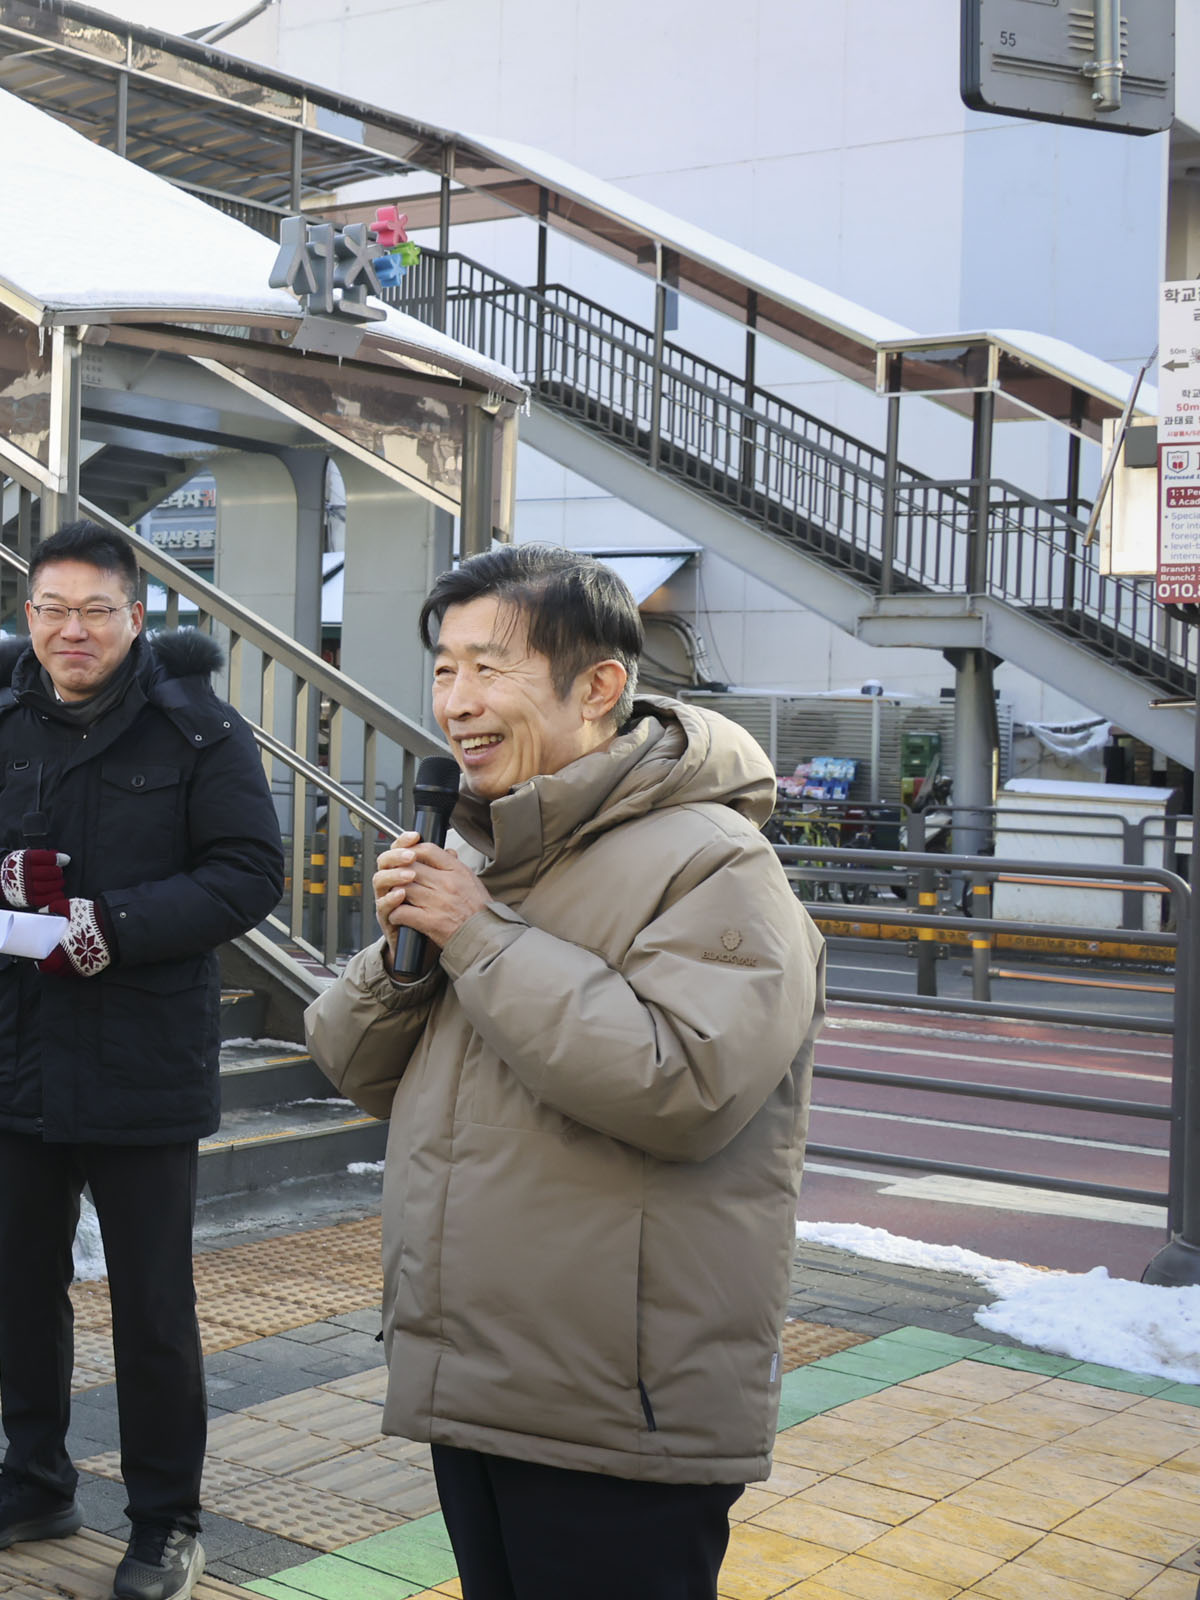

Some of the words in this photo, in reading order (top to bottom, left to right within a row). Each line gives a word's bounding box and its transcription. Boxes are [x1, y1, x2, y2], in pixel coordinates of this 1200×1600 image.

[1000, 31, 1017, 47] 55
[1164, 287, 1200, 303] 학교
[1164, 416, 1194, 425] 과태료
[1170, 489, 1185, 497] 1:1
[1171, 522, 1185, 530] for
[1158, 583, 1200, 598] 010.
